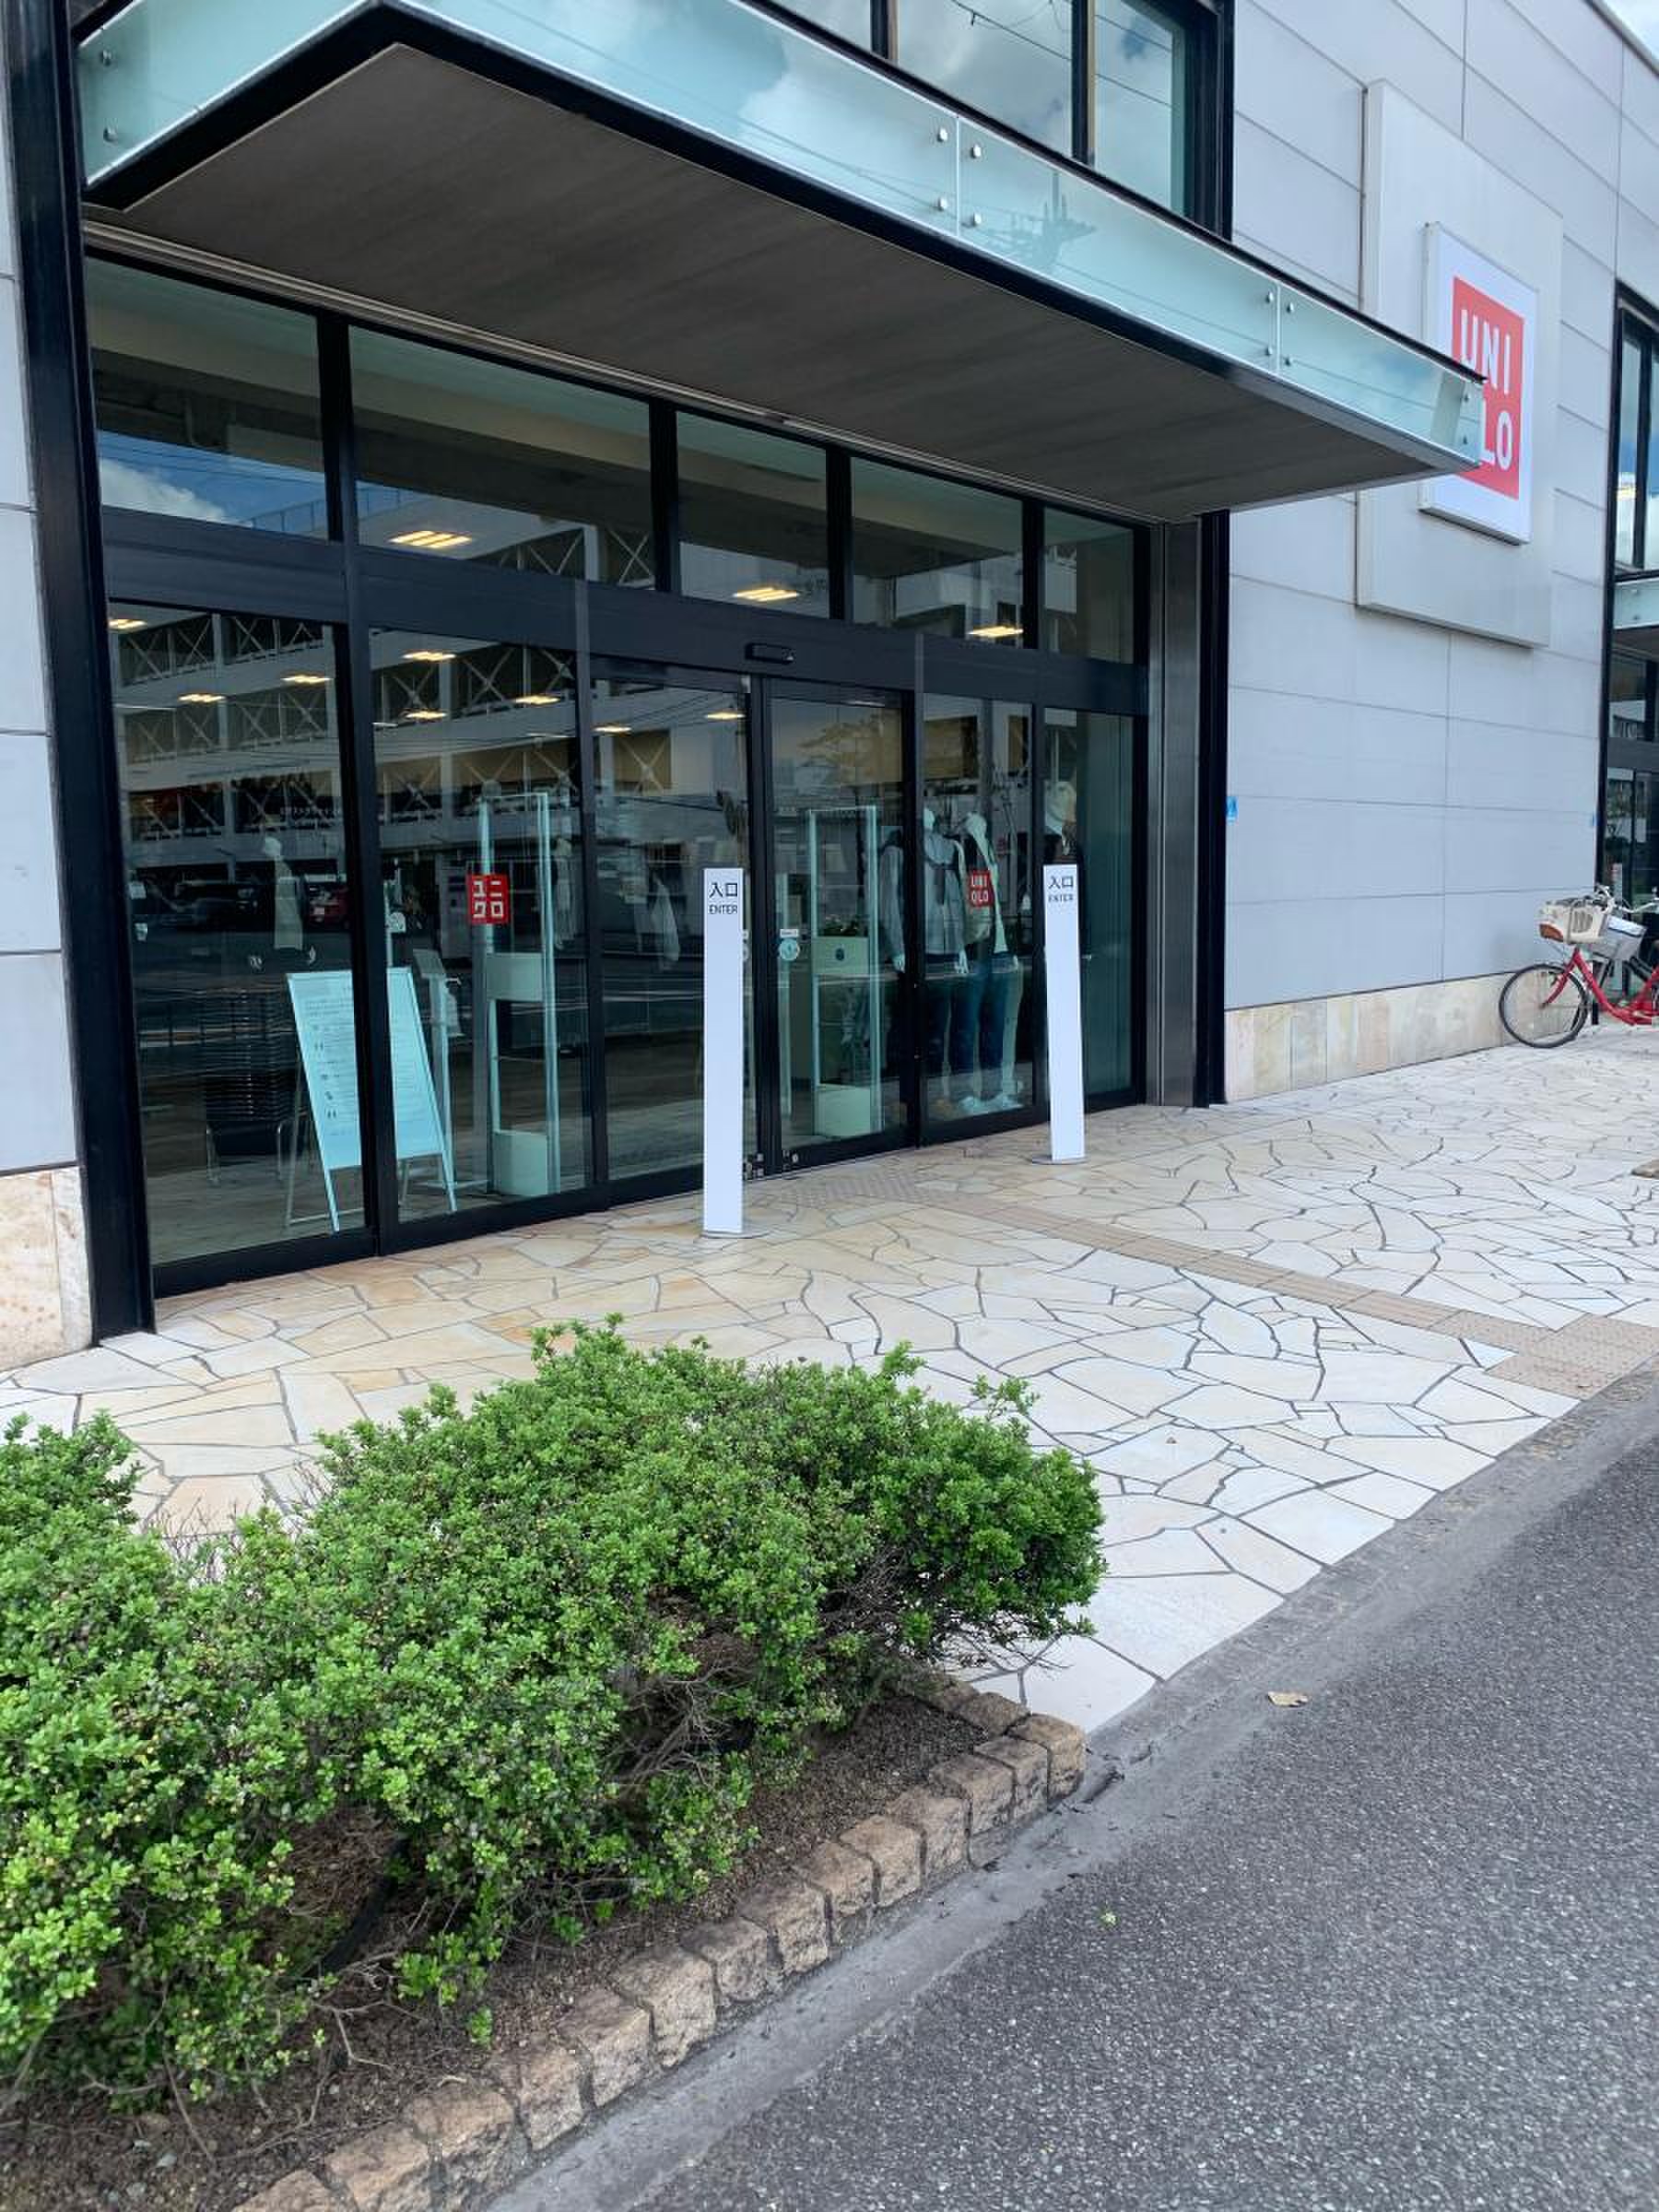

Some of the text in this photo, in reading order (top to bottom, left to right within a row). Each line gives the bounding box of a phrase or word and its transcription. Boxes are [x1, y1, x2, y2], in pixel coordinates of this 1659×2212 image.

[1460, 309, 1511, 395] UNI
[473, 881, 502, 898] ユニ
[708, 882, 739, 898] 入口
[1048, 876, 1075, 889] 入口
[473, 900, 504, 918] クロ
[708, 904, 739, 914] ENTER
